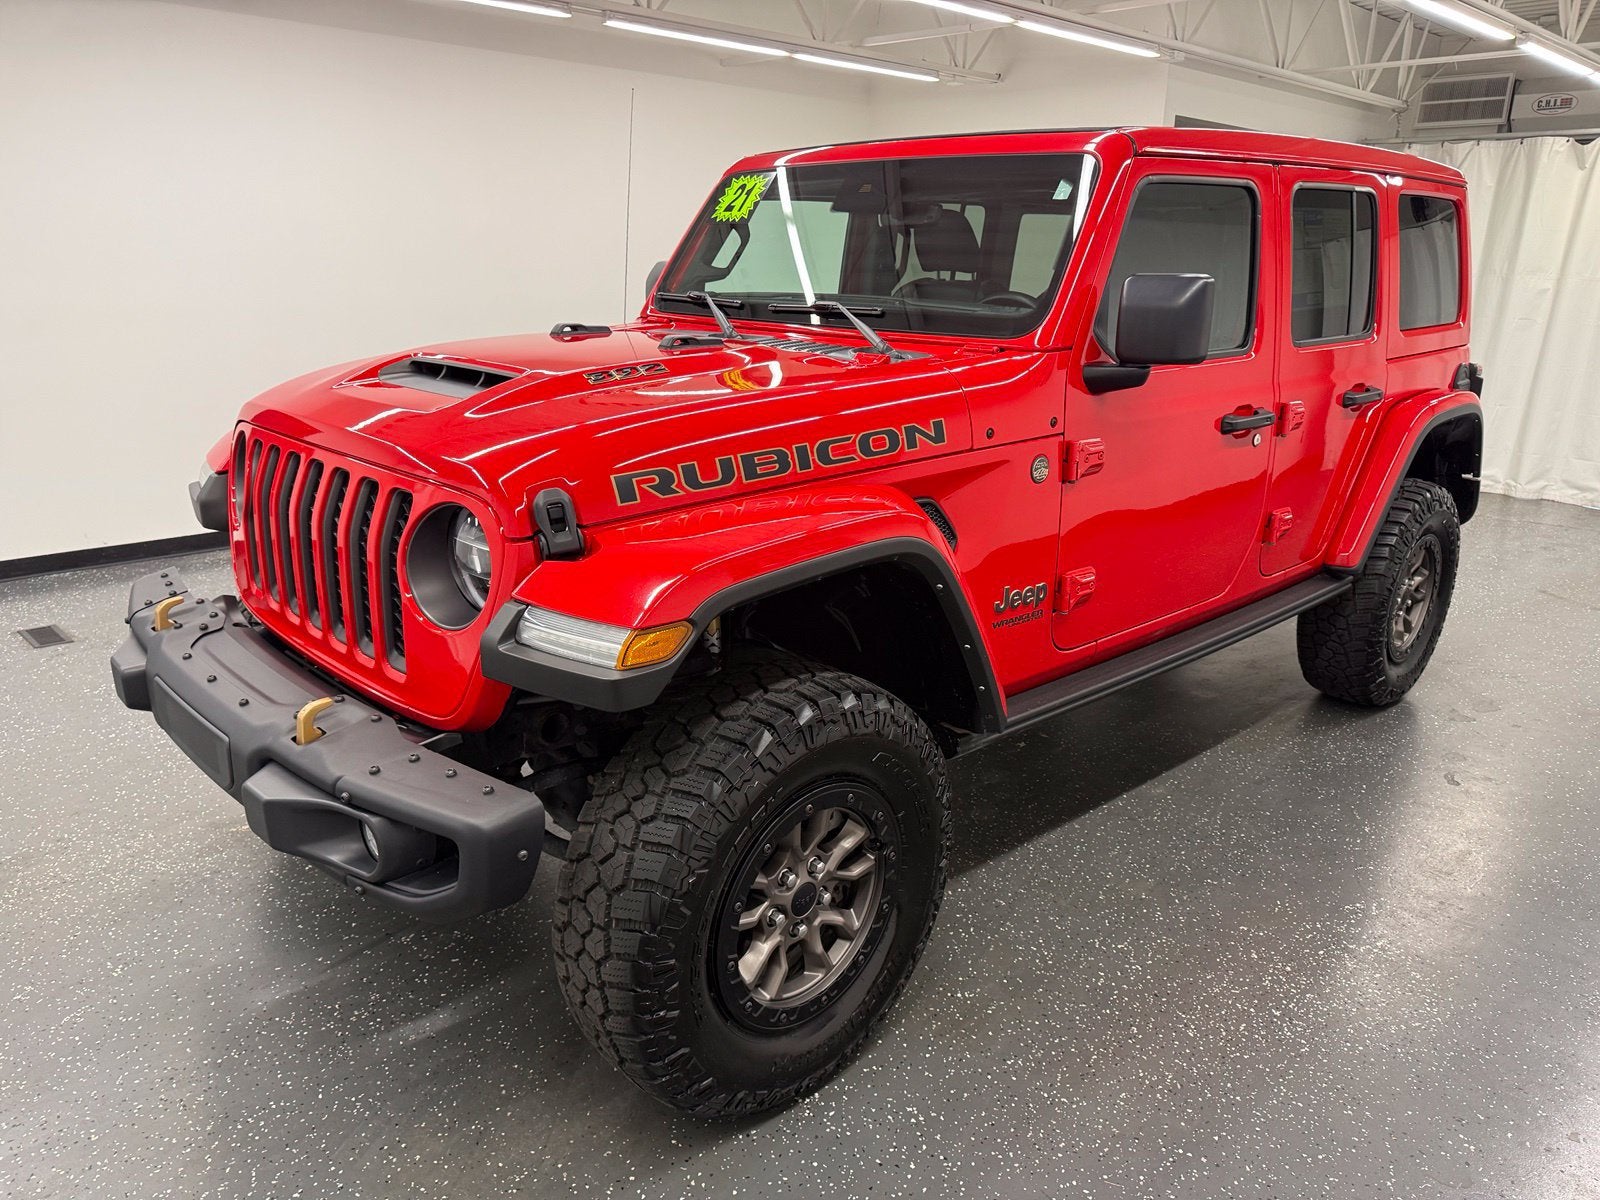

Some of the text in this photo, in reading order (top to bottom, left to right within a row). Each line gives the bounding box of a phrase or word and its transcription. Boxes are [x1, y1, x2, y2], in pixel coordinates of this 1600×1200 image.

[723, 182, 758, 213] 21
[583, 362, 670, 385] 392
[610, 418, 946, 506] RUBICON
[993, 582, 1048, 613] Jeep
[992, 609, 1044, 629] WRANGLER
